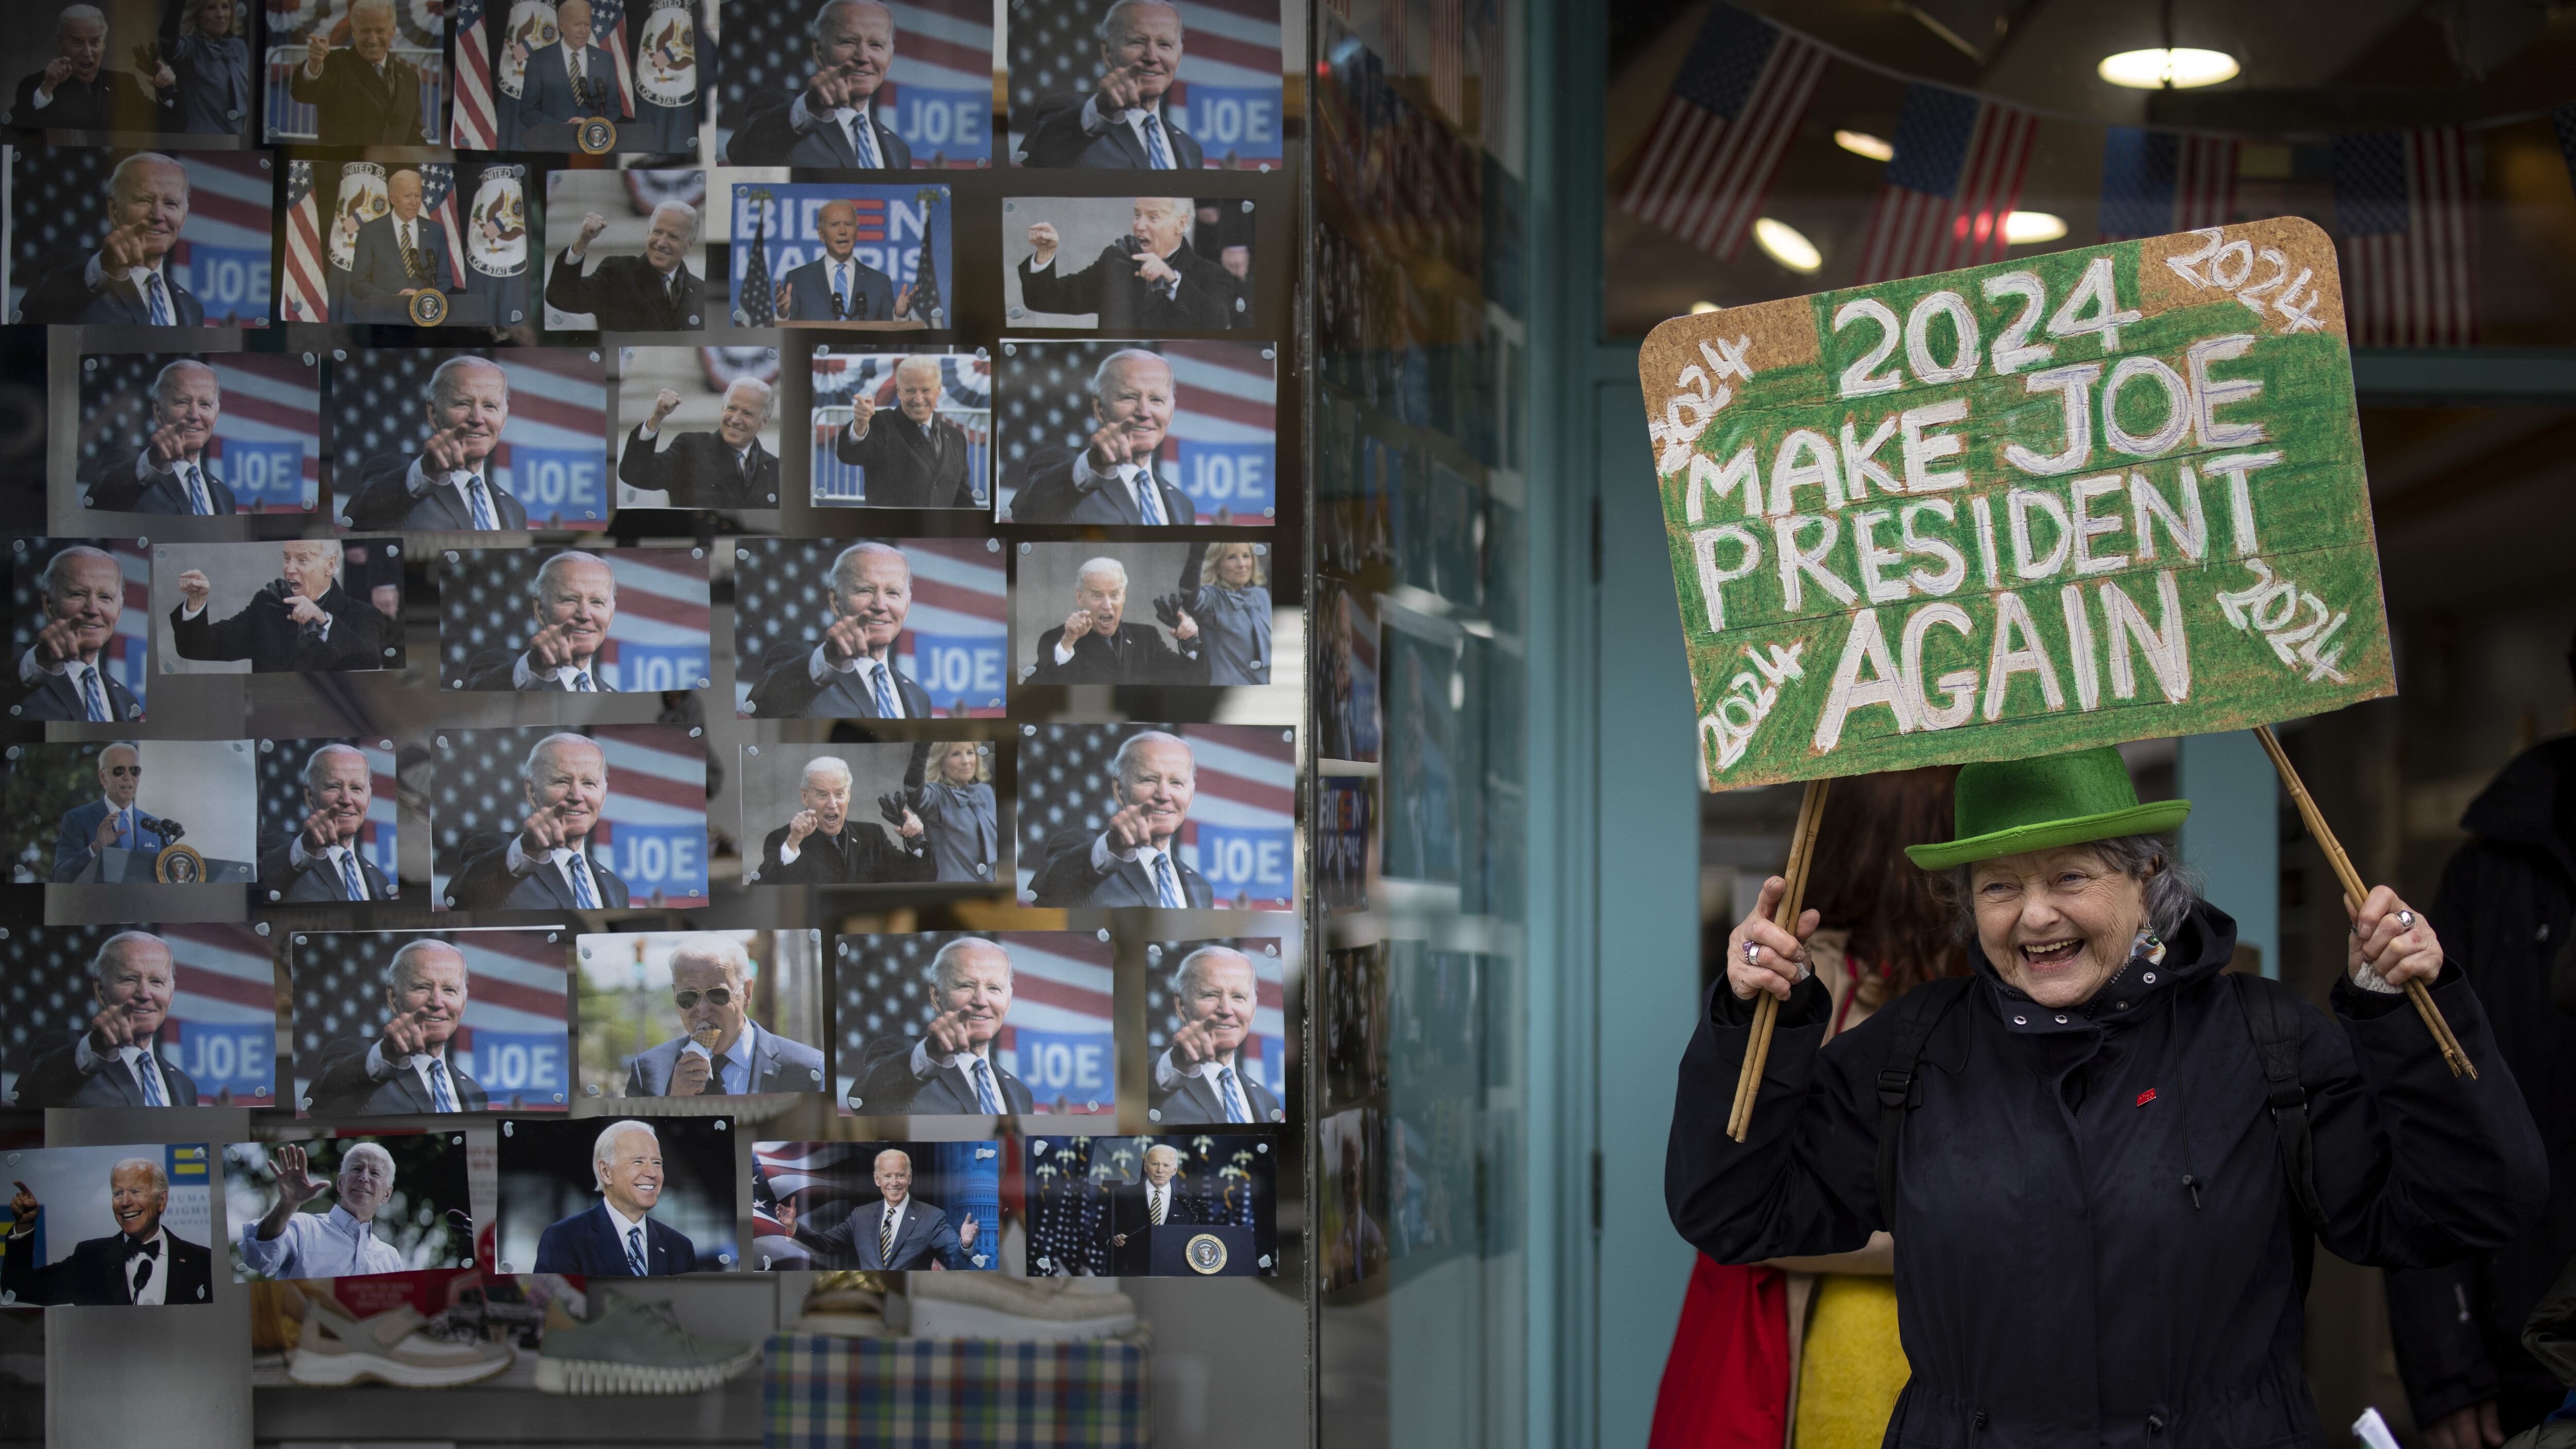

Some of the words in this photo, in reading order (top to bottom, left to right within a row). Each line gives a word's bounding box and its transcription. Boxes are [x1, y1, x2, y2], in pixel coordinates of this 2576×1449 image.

[905, 98, 981, 145] JOE
[1196, 97, 1273, 143] JOE
[479, 169, 512, 180] NITED
[195, 256, 270, 302] JOE
[486, 266, 512, 275] STATE
[2166, 226, 2327, 336] 2024
[1834, 256, 2143, 398] 2024
[1686, 398, 1969, 524] MAKE
[2005, 335, 2273, 475] JOE
[229, 451, 293, 491] JOE
[520, 459, 596, 505] JOE
[1188, 454, 1265, 498] JOE
[1690, 451, 2284, 633] PRESIDENT
[2216, 558, 2349, 684] 2024
[923, 647, 1002, 692] JOE
[1815, 570, 2189, 753] AGAIN
[1699, 641, 1805, 770] 2024
[620, 836, 698, 881] JOE
[1207, 838, 1284, 884] JOE
[190, 1034, 265, 1080] JOE
[481, 1044, 558, 1089] JOE
[1025, 1043, 1103, 1088] JOE
[1188, 1236, 1204, 1253] PRESIDENT
